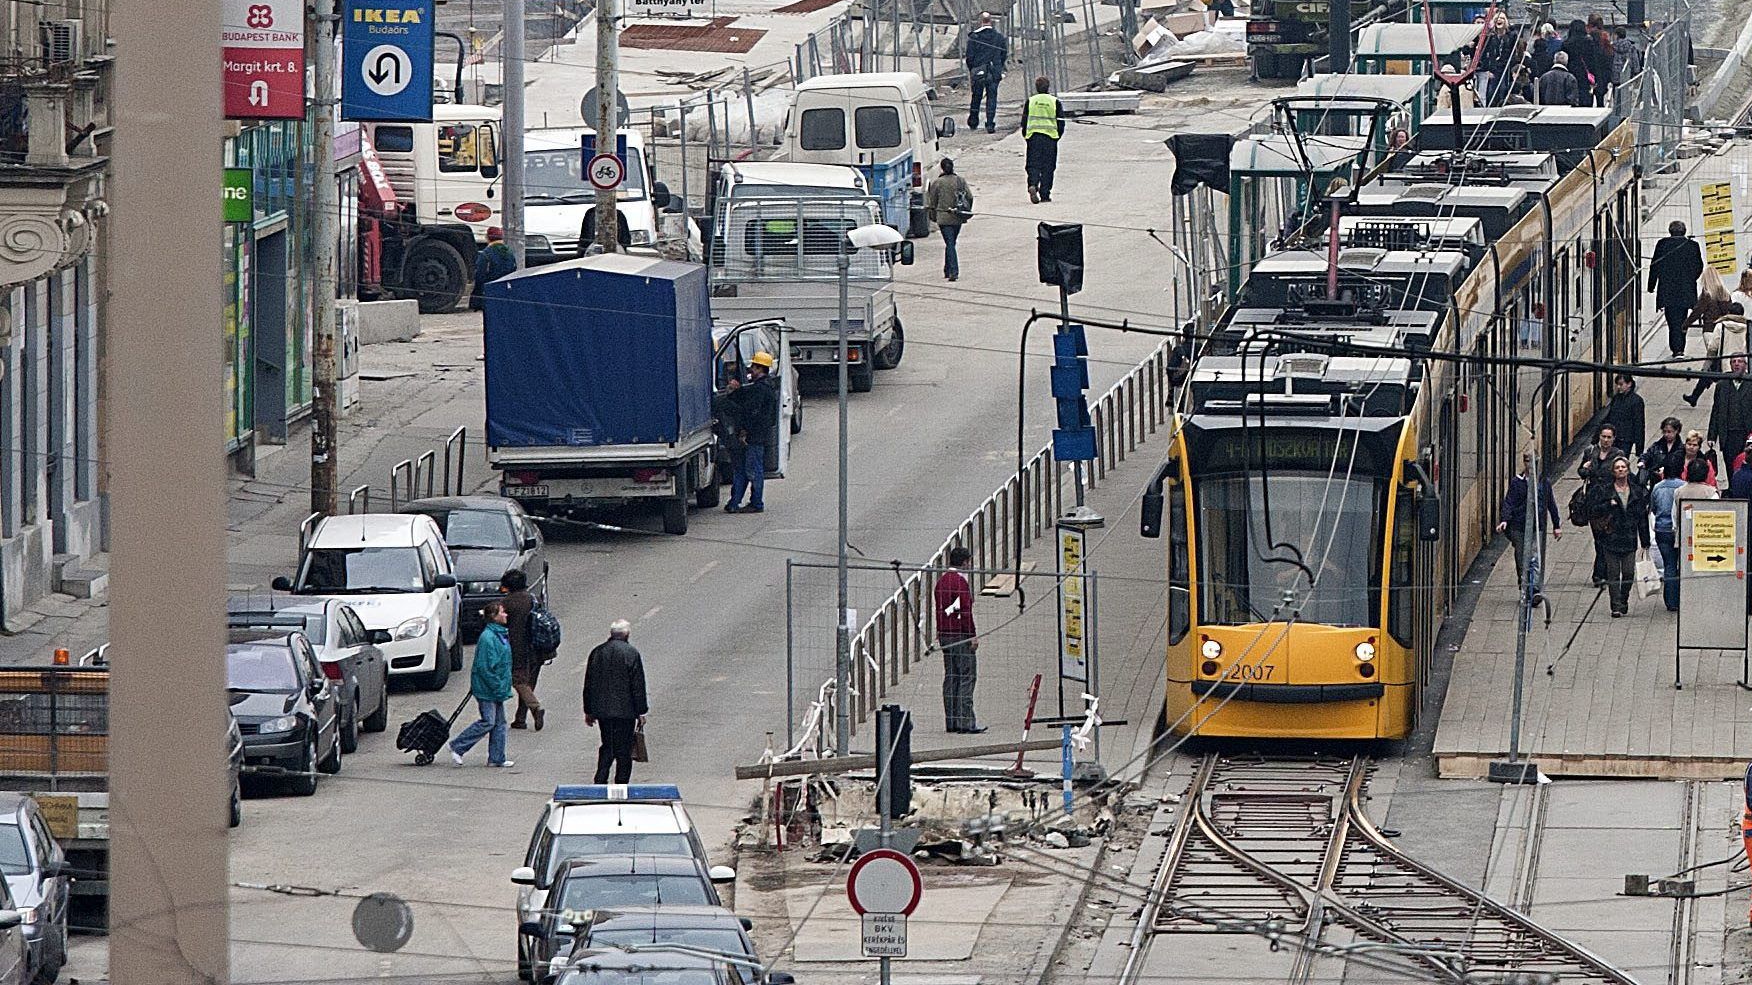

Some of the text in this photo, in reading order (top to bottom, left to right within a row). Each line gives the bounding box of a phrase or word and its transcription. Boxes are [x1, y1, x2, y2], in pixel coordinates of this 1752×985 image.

[353, 9, 421, 24] IKEA
[222, 32, 299, 43] BUDAPEST BANK
[223, 60, 299, 75] Margit krt. 8.
[1230, 663, 1275, 681] 2007
[874, 924, 893, 933] BKV
[863, 934, 905, 945] KERÉKPÁR ÉS
